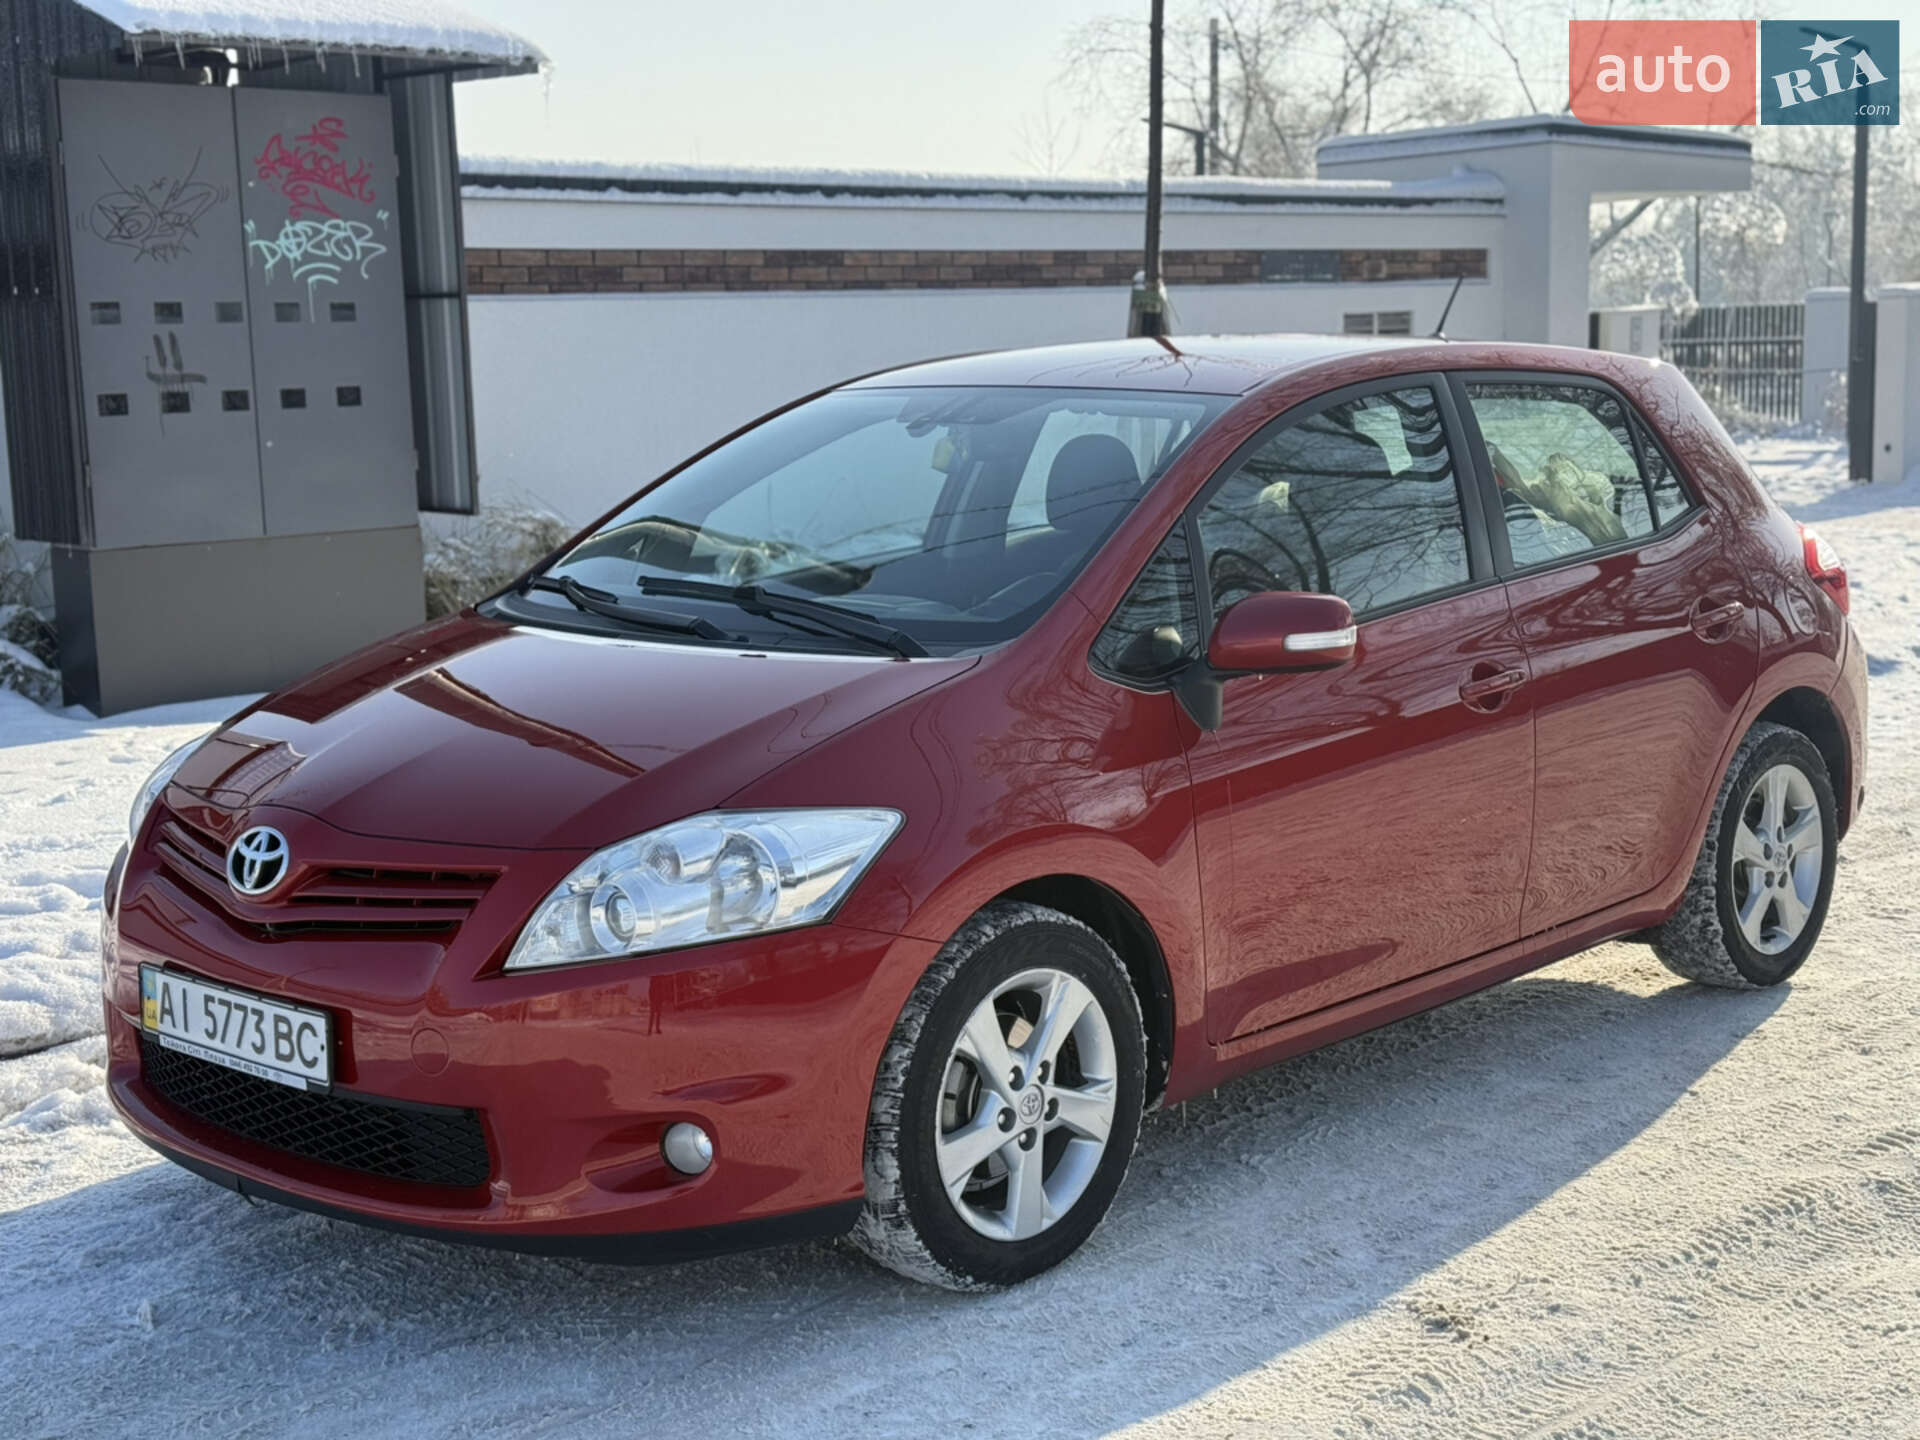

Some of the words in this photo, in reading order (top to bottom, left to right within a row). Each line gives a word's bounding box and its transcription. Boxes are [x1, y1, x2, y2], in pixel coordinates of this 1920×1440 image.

[160, 982, 188, 1033] AI
[203, 994, 266, 1055] 5773
[273, 1014, 318, 1069] BC
